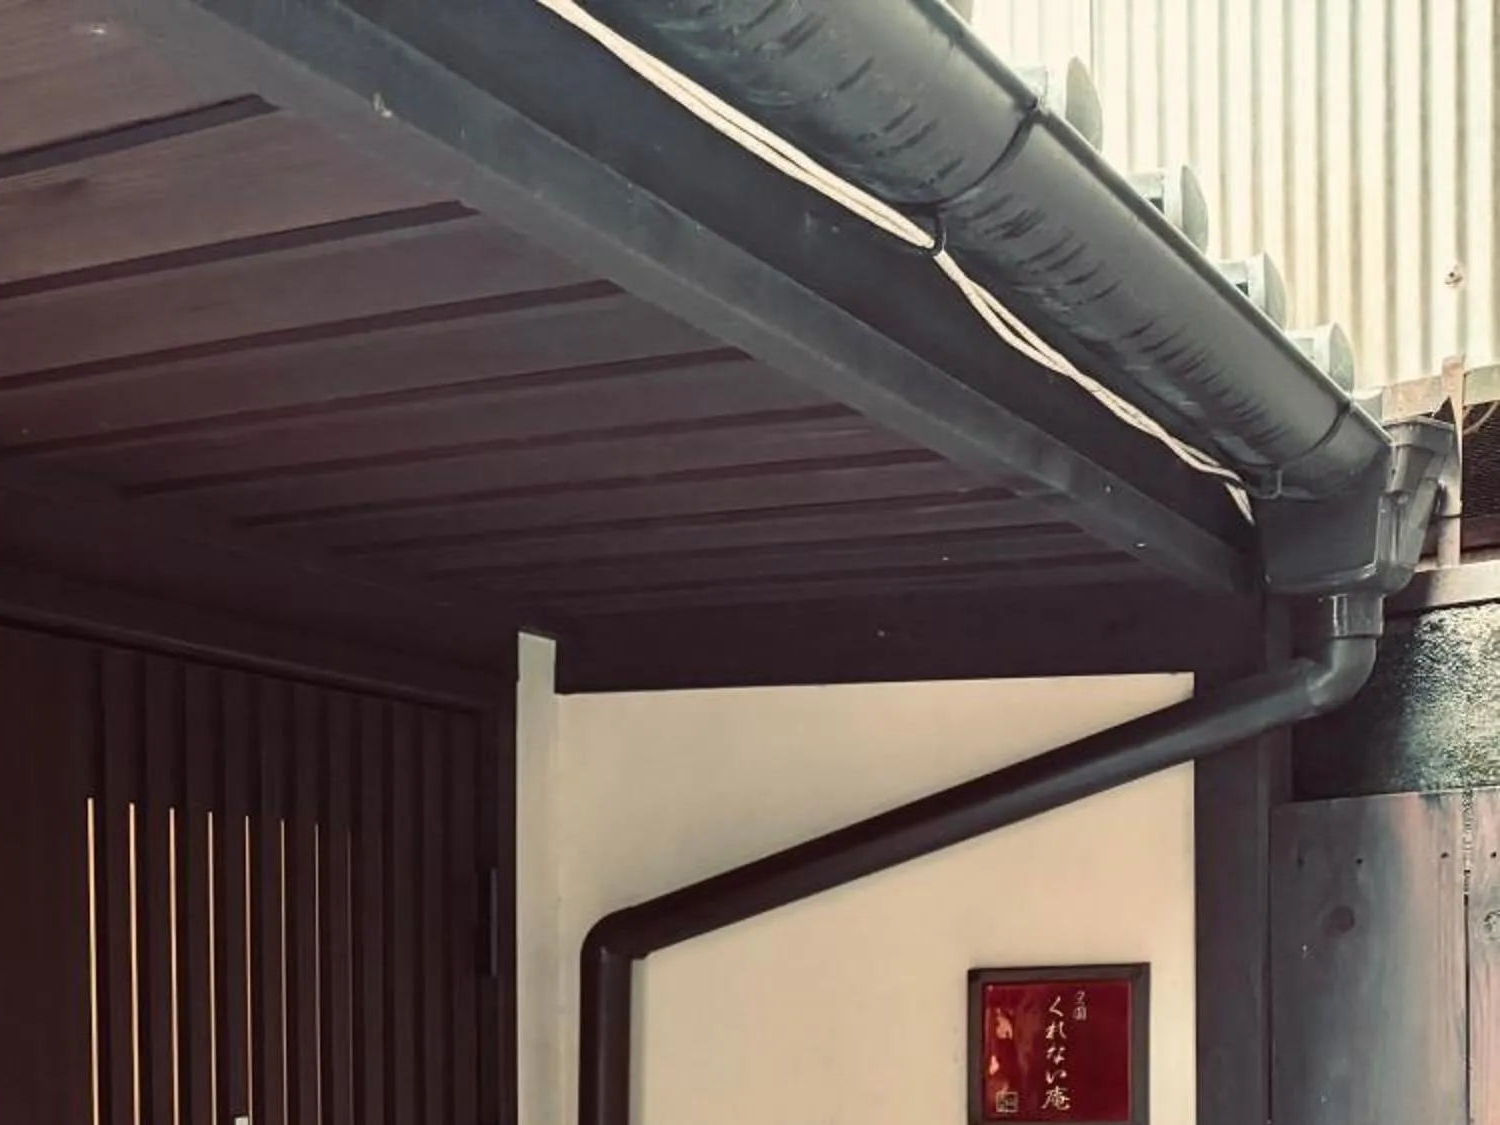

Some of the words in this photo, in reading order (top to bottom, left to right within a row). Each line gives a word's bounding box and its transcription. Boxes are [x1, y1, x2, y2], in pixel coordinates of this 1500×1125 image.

[1041, 996, 1071, 1111] くれない庵
